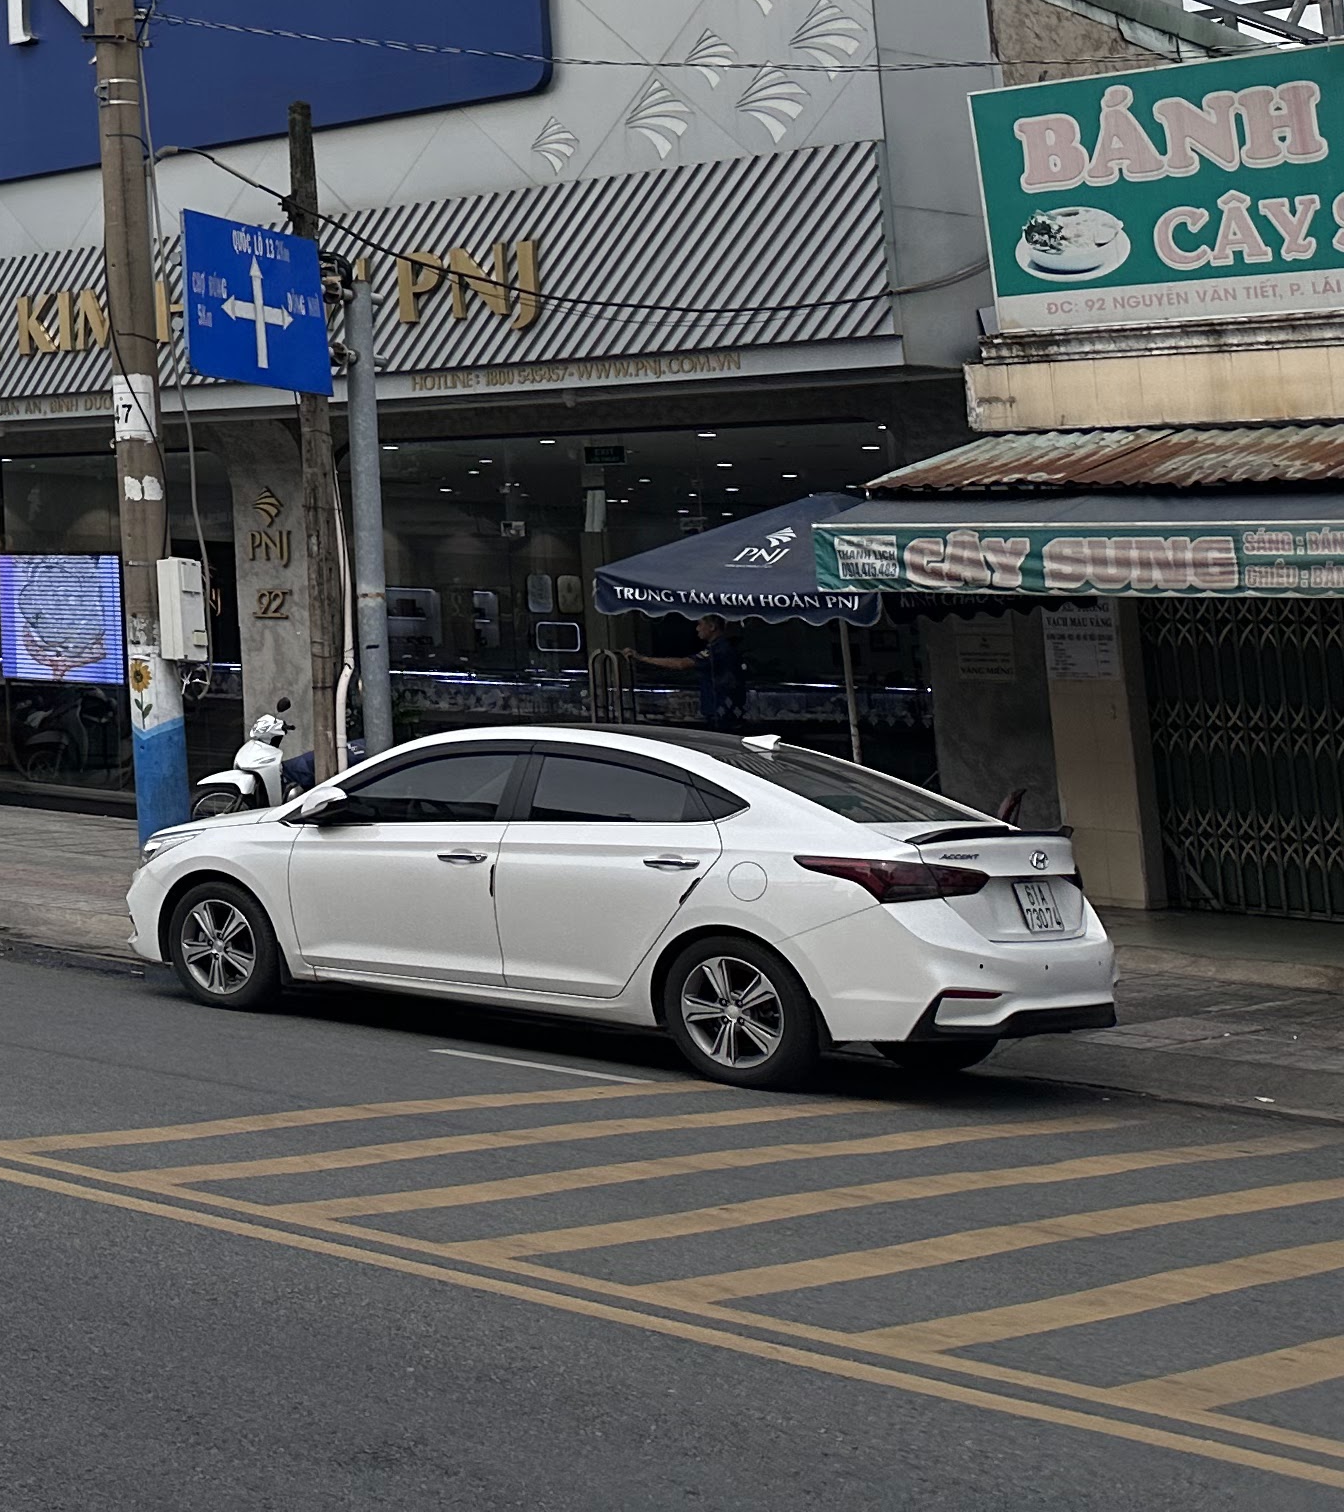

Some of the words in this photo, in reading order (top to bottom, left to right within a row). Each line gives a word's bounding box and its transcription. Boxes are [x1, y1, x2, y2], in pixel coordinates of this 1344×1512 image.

[1014, 84, 1329, 194] BÁNH
[265, 238, 275, 259] 13
[1154, 189, 1320, 270] CÂY
[397, 240, 541, 330] PNJ
[1045, 299, 1079, 316] ĐC:
[1085, 297, 1107, 312] 92
[1113, 288, 1189, 310] NGUYỄN
[1195, 284, 1237, 304] VĂN
[1245, 280, 1283, 301] TIẾT,
[1289, 282, 1305, 297] P.
[1312, 278, 1342, 295] LÁI
[17, 288, 111, 356] KIM
[249, 530, 292, 568] PNJ
[732, 546, 791, 565] PNJ
[903, 529, 1030, 588] CÂY
[1042, 536, 1238, 589] SUNG
[1307, 527, 1344, 555] BÁN
[256, 589, 285, 617] 92
[613, 586, 674, 603] TRUNG
[680, 588, 716, 605] TÂM
[720, 592, 755, 607] KIM
[759, 591, 820, 609] HOÀN
[827, 595, 860, 611] PNJ
[1024, 884, 1048, 906] 61A
